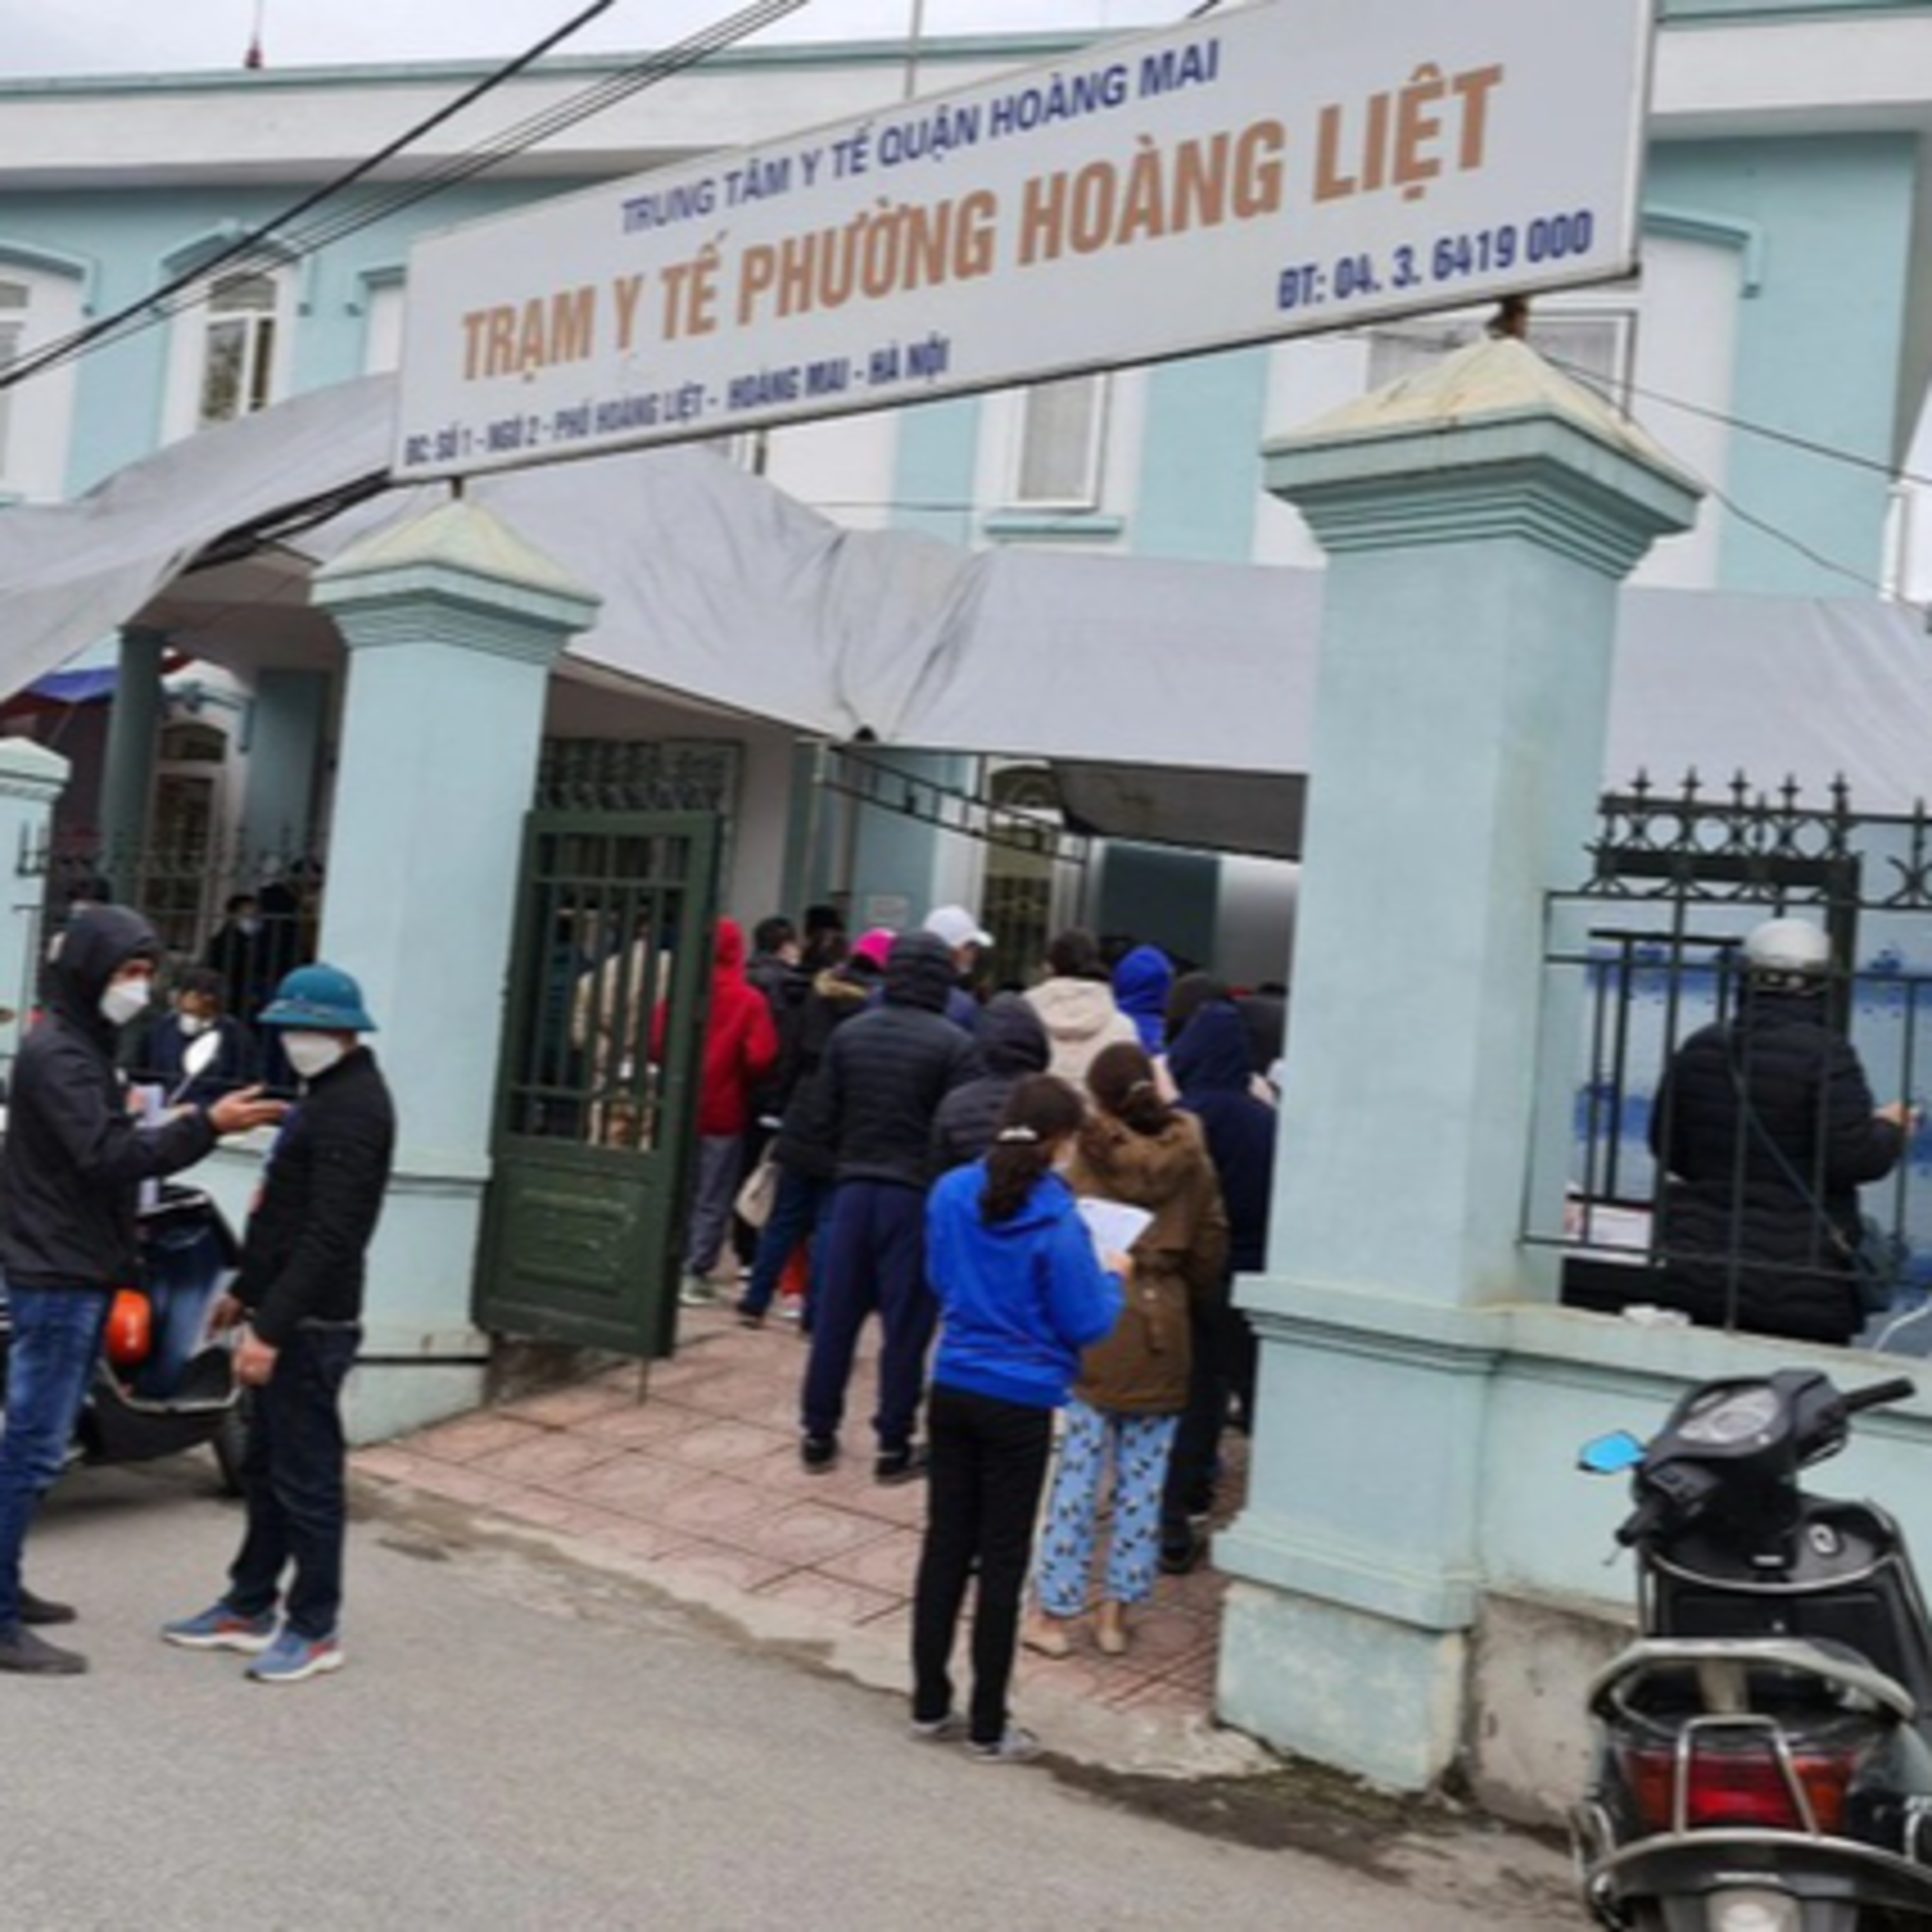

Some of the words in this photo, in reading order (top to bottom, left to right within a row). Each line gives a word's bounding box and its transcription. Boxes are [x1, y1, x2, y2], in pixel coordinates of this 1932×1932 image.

[622, 180, 715, 234] TRUNG
[724, 157, 792, 207] TÂM
[801, 148, 822, 186] Y
[831, 120, 874, 178] TẾ
[878, 104, 980, 167] QUẬN
[990, 64, 1128, 137] HOÀNG
[1139, 39, 1219, 98] MAI
[462, 285, 598, 383] TRẠM
[613, 273, 645, 349] Y
[660, 230, 728, 339] TẾ
[737, 189, 998, 325] PHƯỜNG
[1017, 118, 1287, 265] HOÀNG
[1312, 61, 1503, 204] LIỆT
[1433, 224, 1517, 281] 6419
[1526, 210, 1594, 263] 000
[728, 366, 800, 412] HOÀNG
[805, 357, 850, 397] MAI
[869, 339, 900, 385] HÀ
[907, 330, 951, 383] NỘI
